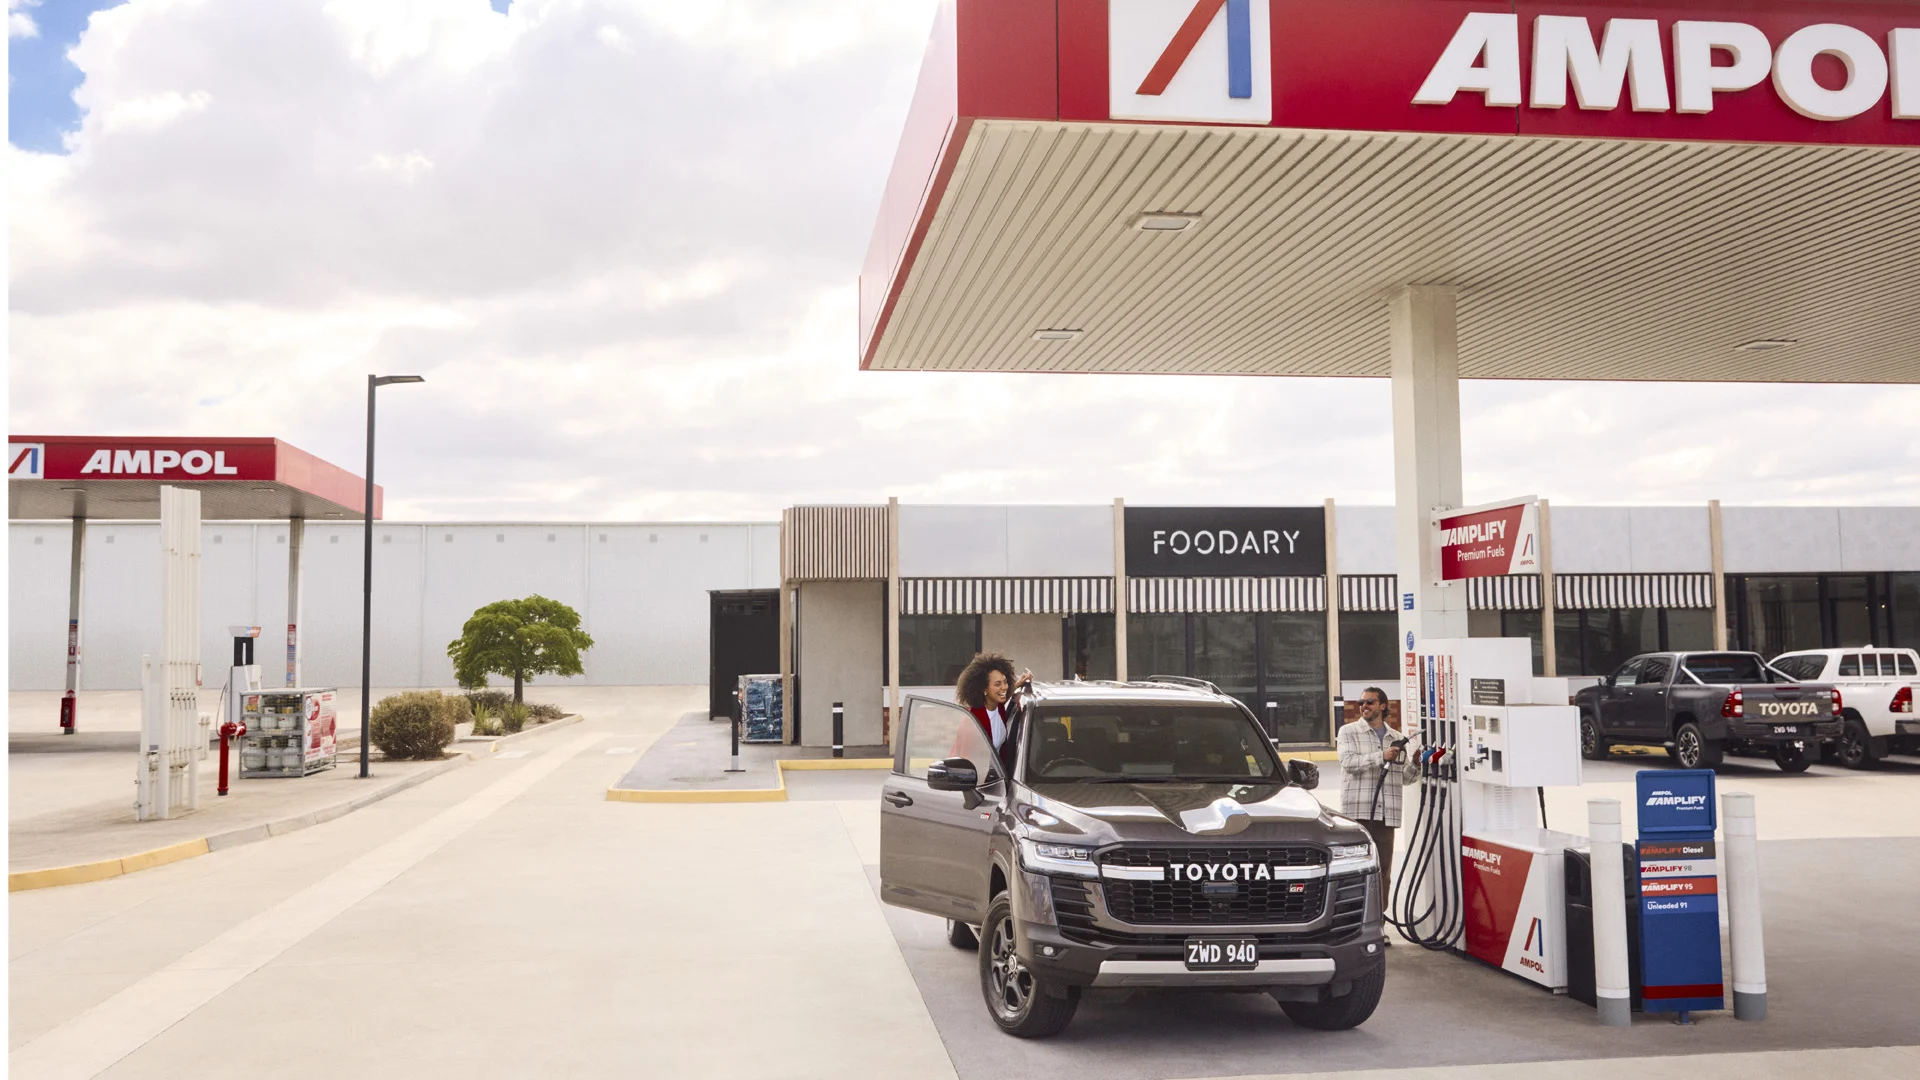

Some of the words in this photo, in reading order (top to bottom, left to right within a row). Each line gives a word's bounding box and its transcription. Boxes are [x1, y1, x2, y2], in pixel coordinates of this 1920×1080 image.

[80, 449, 238, 475] AMPOL
[1448, 519, 1507, 547] AMPLIFY
[1153, 530, 1300, 555] FOODARY
[1457, 548, 1486, 562] Premium
[1486, 544, 1505, 558] Fuels
[1759, 702, 1818, 715] TOYOTA
[1655, 796, 1706, 805] AMPLIFY
[1468, 849, 1501, 866] AMPLIFY
[1170, 864, 1271, 881] TOYOTA
[1473, 862, 1490, 872] Premium
[1490, 867, 1501, 875] Fuels
[1188, 944, 1221, 963] ZWD
[1226, 944, 1256, 963] 940
[1519, 957, 1544, 973] AMPOL
